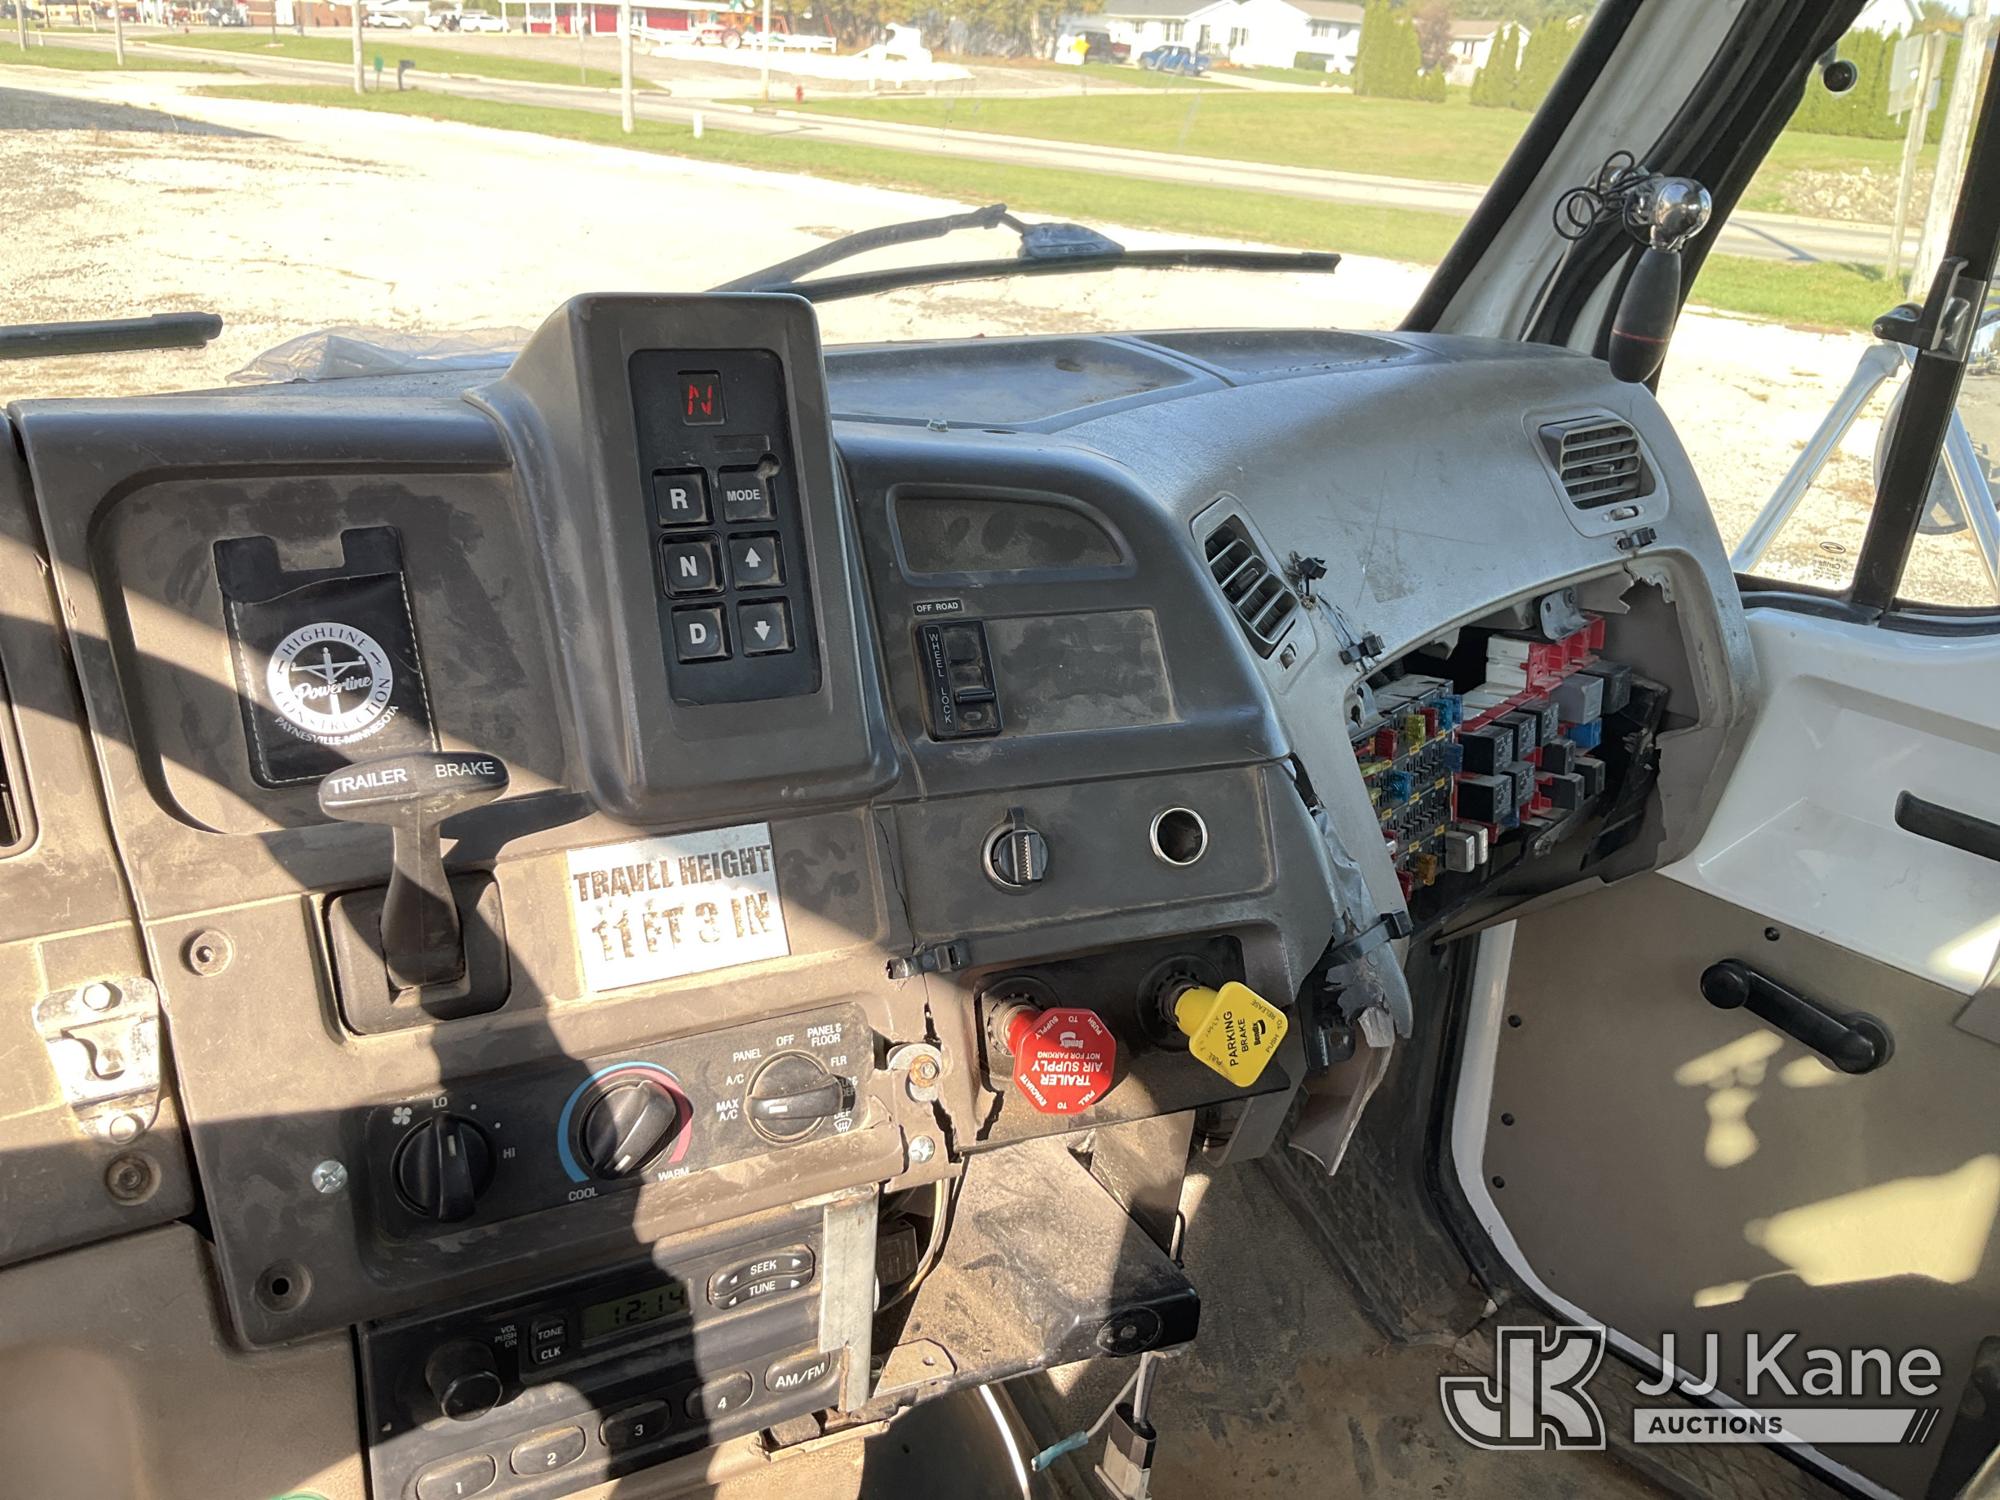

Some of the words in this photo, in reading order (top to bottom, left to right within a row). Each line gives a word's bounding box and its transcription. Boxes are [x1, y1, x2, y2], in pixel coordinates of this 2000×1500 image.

[687, 384, 713, 415] N
[669, 488, 689, 510] R
[726, 489, 761, 502] MODE
[679, 556, 698, 577] N
[916, 604, 932, 613] OFF
[935, 602, 959, 611] ROAD
[282, 626, 367, 656] HIGHLINE
[689, 623, 708, 645] D
[928, 633, 945, 677] WHEEL
[941, 687, 953, 724] LOCK
[292, 676, 373, 700] Powerline
[329, 767, 408, 794] TRAILER
[434, 761, 496, 779] BRAKE
[573, 860, 674, 902] TRAVEL
[678, 844, 771, 886] HEIGHT
[731, 891, 772, 939] IN
[1252, 999, 1276, 1021] RELEASE
[1035, 1015, 1059, 1040] SUPPLY
[1088, 1016, 1103, 1036] PUSH
[1276, 1019, 1283, 1030] TO
[807, 1026, 834, 1038] PANEL
[1223, 1010, 1239, 1067] PARKING
[1238, 1018, 1249, 1052] BRAKE
[776, 1034, 795, 1047] OFF
[812, 1034, 841, 1047] FLOOR
[1266, 1034, 1279, 1053] PUSH
[733, 1048, 762, 1062] PANEL
[831, 1055, 847, 1067] FLR
[1037, 1051, 1069, 1060] PARKING
[1070, 1052, 1085, 1060] FOR
[1086, 1052, 1101, 1060] NOT
[1031, 1060, 1080, 1073] SUPPLY
[1083, 1062, 1103, 1072] AIR
[726, 1074, 744, 1086] A/C
[1040, 1074, 1091, 1086] TRAILER
[1019, 1073, 1048, 1107] EVACUATE
[432, 1097, 448, 1109] LO
[1078, 1090, 1096, 1106] PULL
[717, 1099, 739, 1113] MAX
[719, 1110, 738, 1121] A/C
[503, 1147, 515, 1159] HI
[658, 1167, 690, 1181] WARM
[568, 1187, 598, 1201] COOL
[750, 1260, 776, 1275] SEEK
[749, 1281, 776, 1296] TUNE
[615, 1287, 685, 1325] 12:14
[501, 1324, 516, 1333] VOL
[537, 1326, 564, 1341] TONE
[495, 1332, 517, 1343] PUSH
[505, 1338, 517, 1348] ON
[541, 1347, 561, 1360] CLK
[775, 1362, 825, 1388] AM/FM
[718, 1397, 727, 1409] 4
[635, 1424, 644, 1436] 3
[547, 1452, 557, 1465] 2
[455, 1482, 463, 1494] 1
